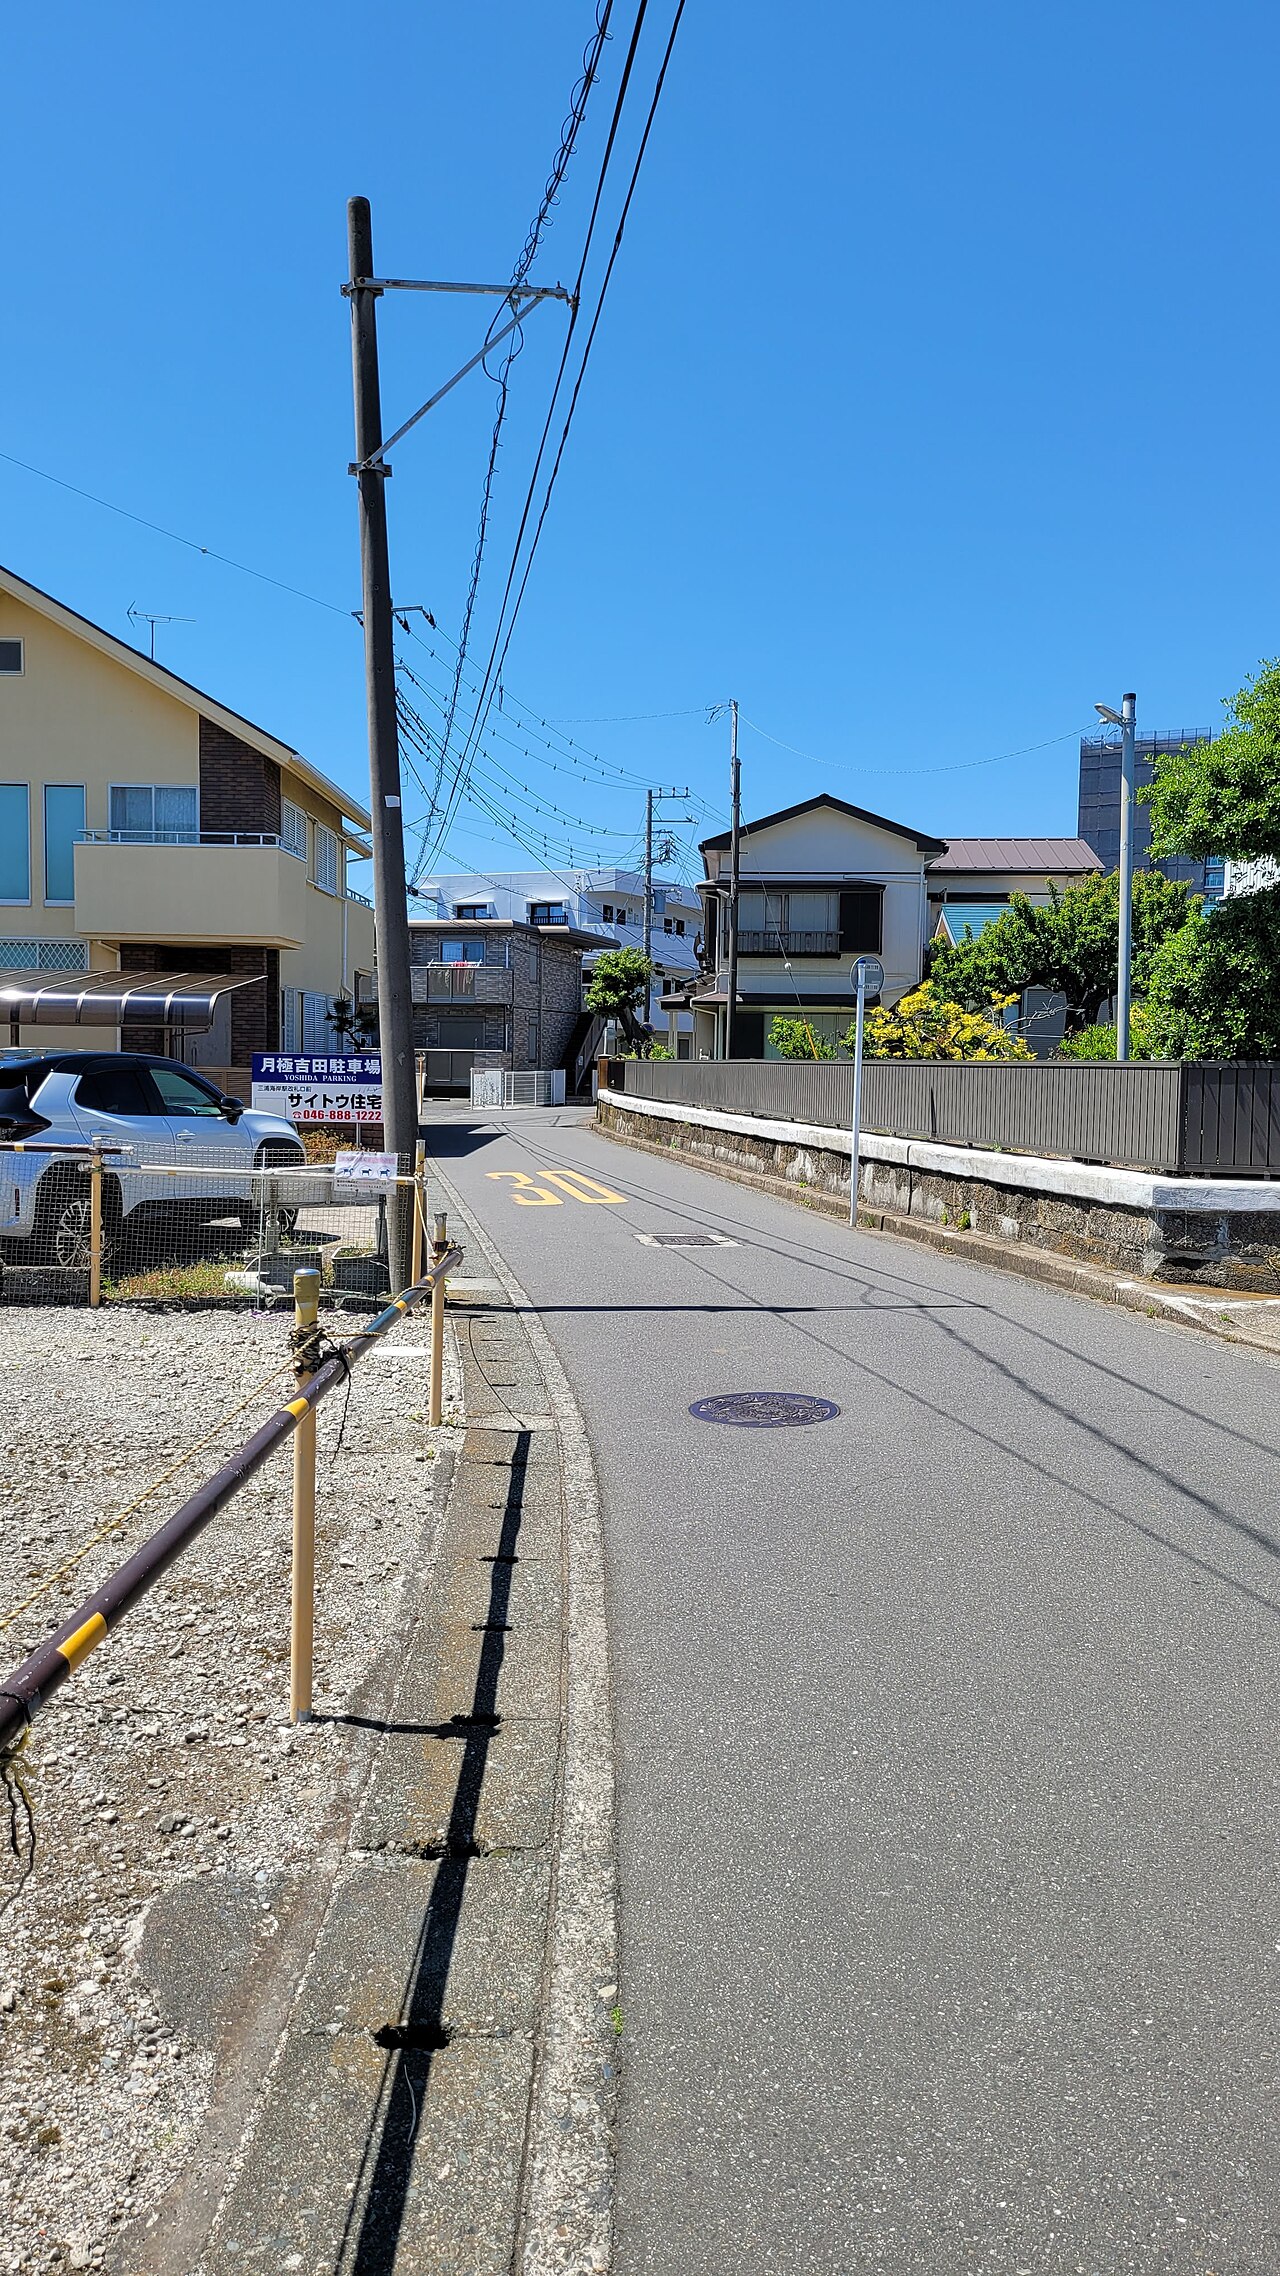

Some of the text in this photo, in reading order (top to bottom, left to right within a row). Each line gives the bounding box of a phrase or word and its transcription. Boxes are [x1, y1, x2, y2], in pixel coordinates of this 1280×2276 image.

[260, 1057, 381, 1075] 月極吉田駐車場
[284, 1074, 318, 1082] YOSHIDA
[288, 1093, 382, 1110] サイトウ住宅
[303, 1110, 382, 1120] 046-888-1222
[485, 1170, 629, 1206] 30
